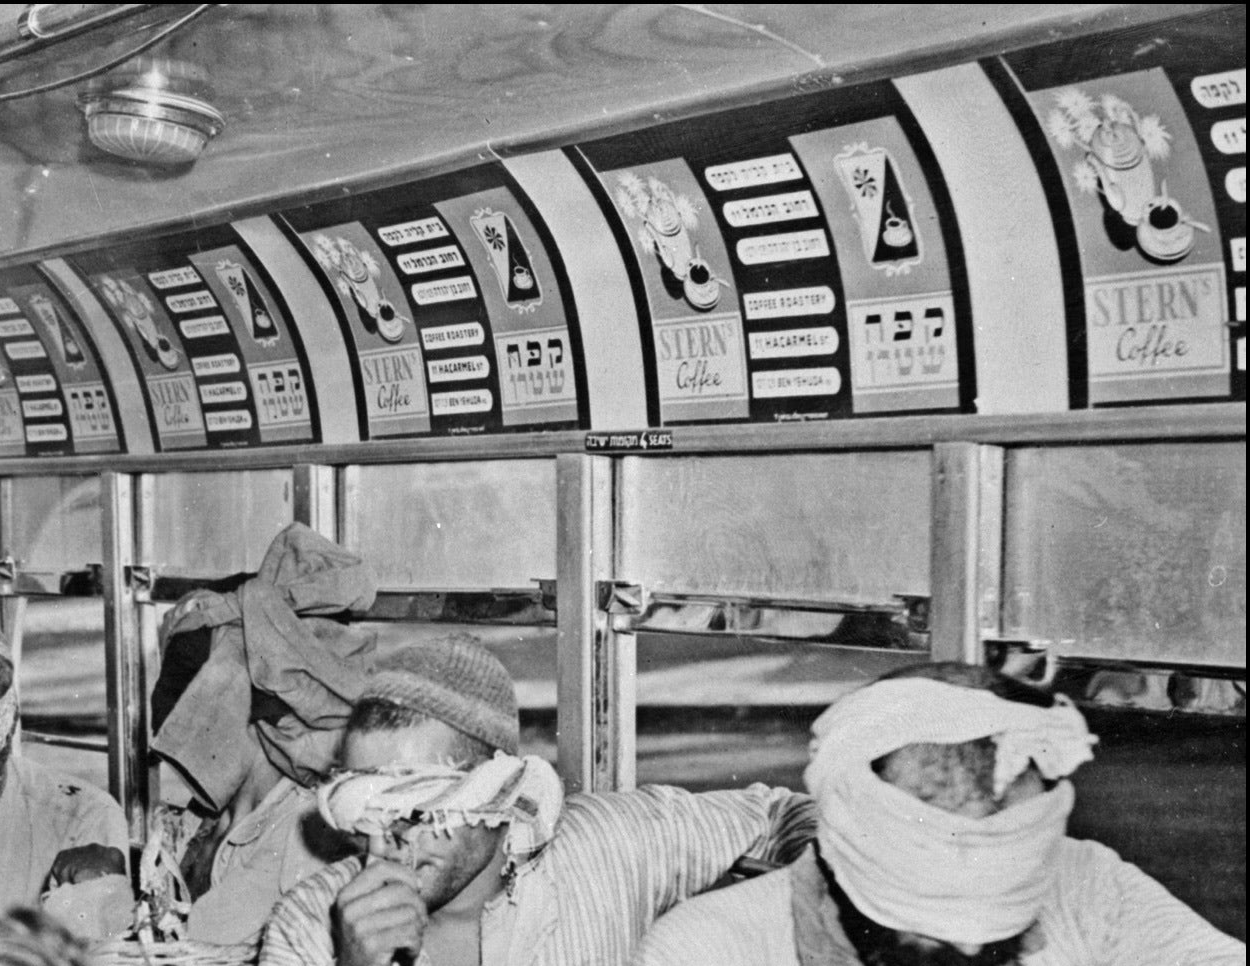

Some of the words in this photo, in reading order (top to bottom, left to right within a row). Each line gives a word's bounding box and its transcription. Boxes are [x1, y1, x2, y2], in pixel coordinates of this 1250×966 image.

[1201, 79, 1242, 102] לקפה
[410, 255, 439, 269] הכרמל
[438, 251, 460, 264] רחוב
[748, 298, 778, 312] COFFEE
[779, 293, 828, 309] ROASTERY
[424, 331, 446, 344] COFFEE
[445, 328, 479, 341] ROASTERY
[765, 332, 819, 350] HACARMEL
[1115, 324, 1190, 367] Coffee
[505, 337, 564, 369] קפה
[865, 344, 946, 384] שטרן
[438, 360, 477, 374] HACARMEL
[676, 359, 723, 394] Coffee
[257, 368, 301, 395] קפה
[510, 368, 565, 401] שטרן
[377, 383, 411, 413] Coffee
[639, 431, 648, 450] 4
[648, 433, 673, 446] SEATS
